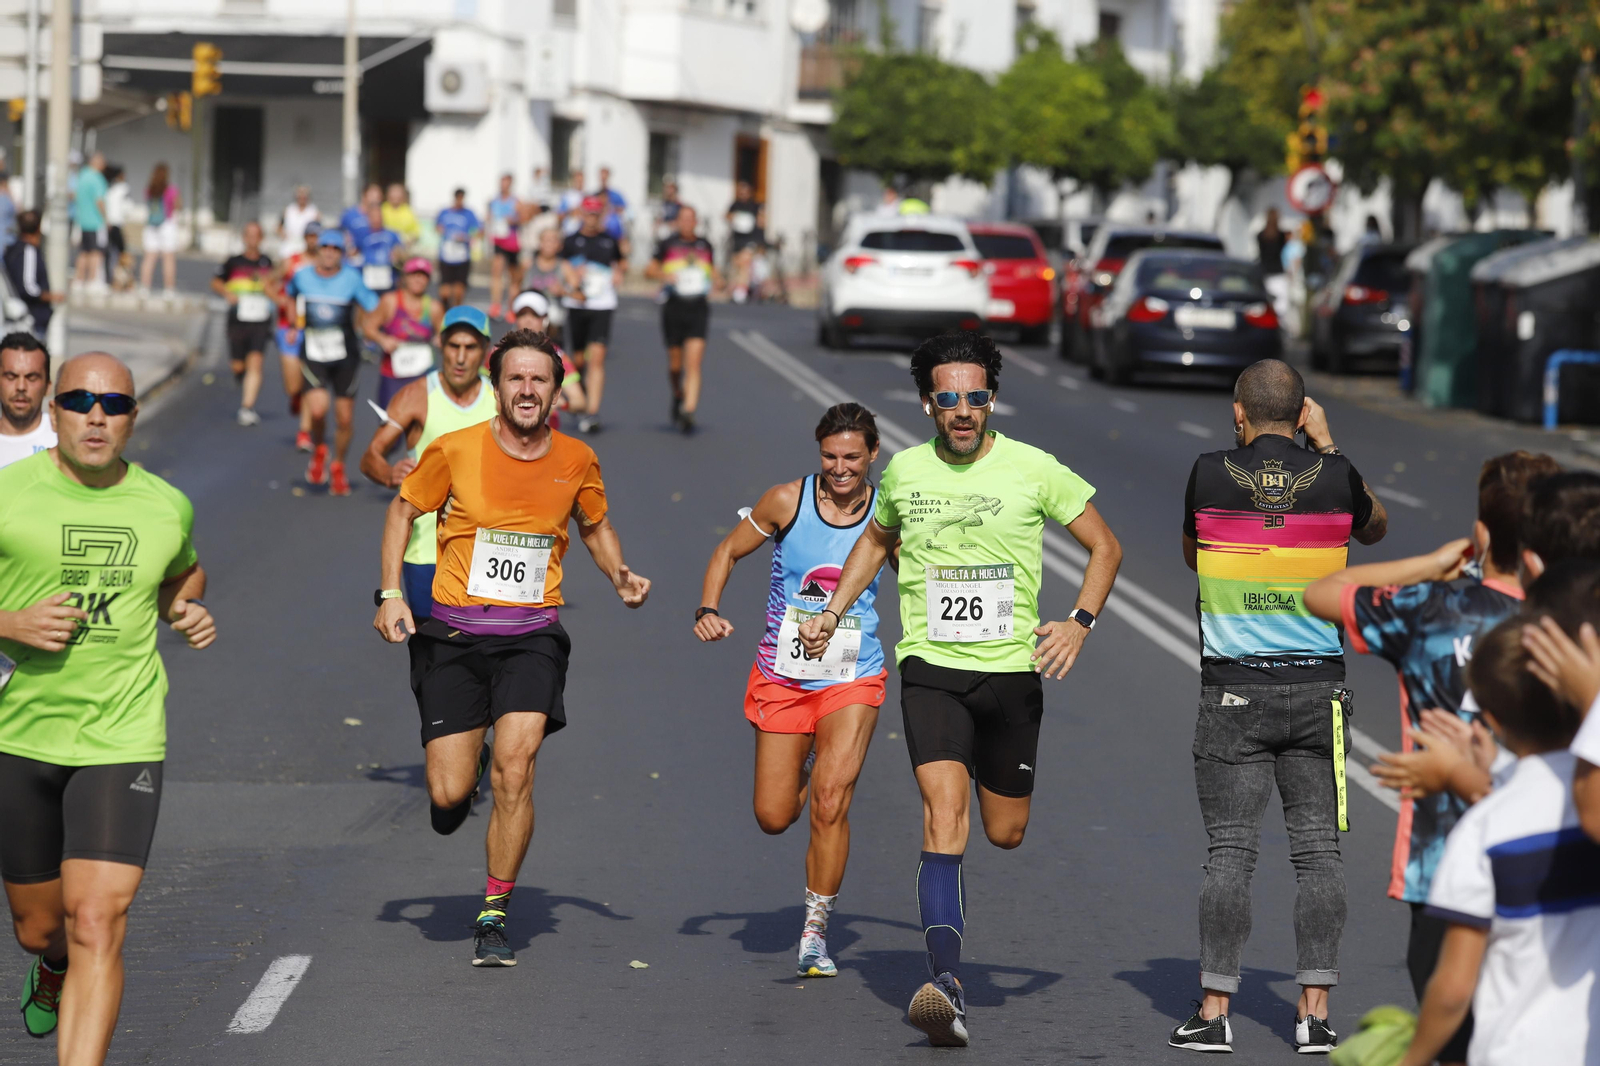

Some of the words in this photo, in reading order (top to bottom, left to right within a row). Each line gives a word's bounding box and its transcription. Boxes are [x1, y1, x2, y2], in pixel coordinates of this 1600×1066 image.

[1261, 473, 1288, 488] B&T
[481, 532, 491, 542] 34
[493, 534, 518, 546] VUELTA
[520, 537, 526, 547] A
[527, 537, 549, 548] HUELVA
[486, 557, 526, 584] 306
[931, 569, 940, 579] 34
[941, 569, 969, 580] VUELTA
[971, 569, 977, 580] A
[979, 567, 1008, 580] HUELVA
[98, 570, 133, 587] HUELVA
[1243, 592, 1296, 605] IBHOLA
[941, 596, 983, 621] 226
[1244, 603, 1264, 611] TRAIL
[1264, 604, 1296, 612] RUNNING
